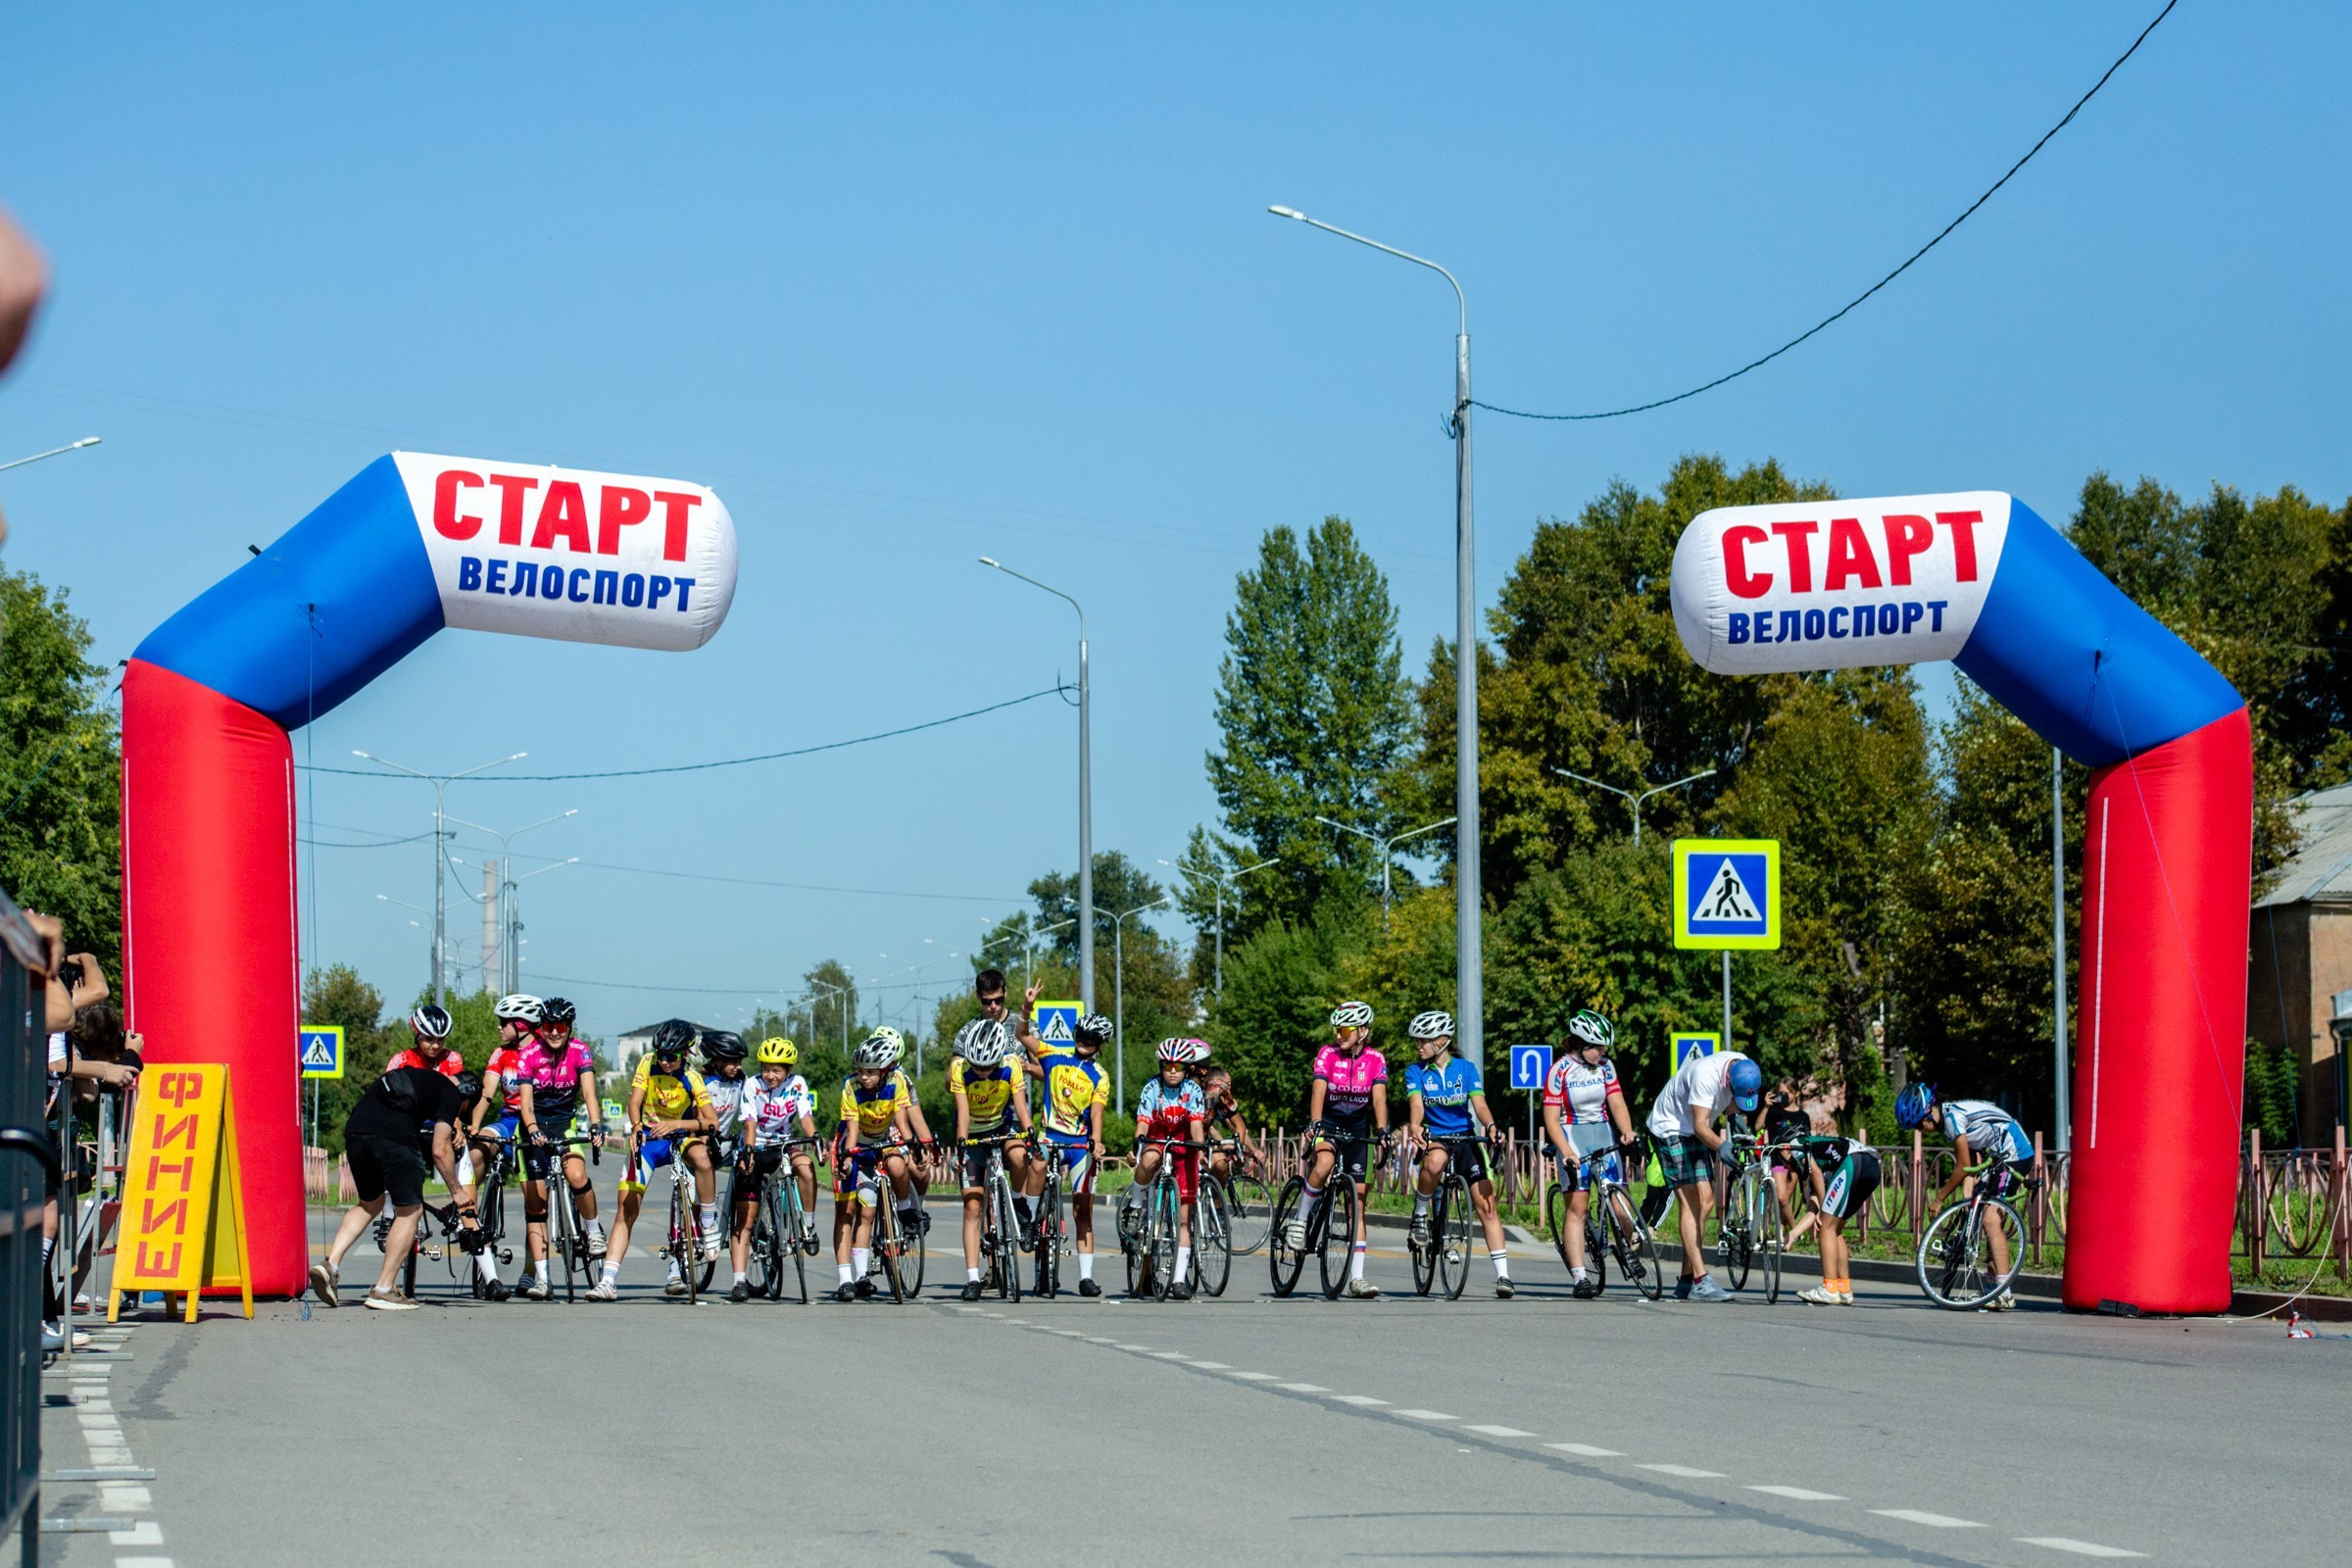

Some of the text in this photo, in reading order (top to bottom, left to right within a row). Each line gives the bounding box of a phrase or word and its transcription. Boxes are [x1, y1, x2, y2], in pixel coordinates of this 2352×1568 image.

[433, 469, 703, 563] СТАРТ
[459, 556, 696, 612] ВЕЛОСПОРТ
[1722, 510, 1984, 599] СТАРТ
[1728, 601, 1948, 645] ВЕЛОСПОРТ
[1568, 1077, 1603, 1089] RUSSIA
[134, 1072, 203, 1278] ФИНИШ
